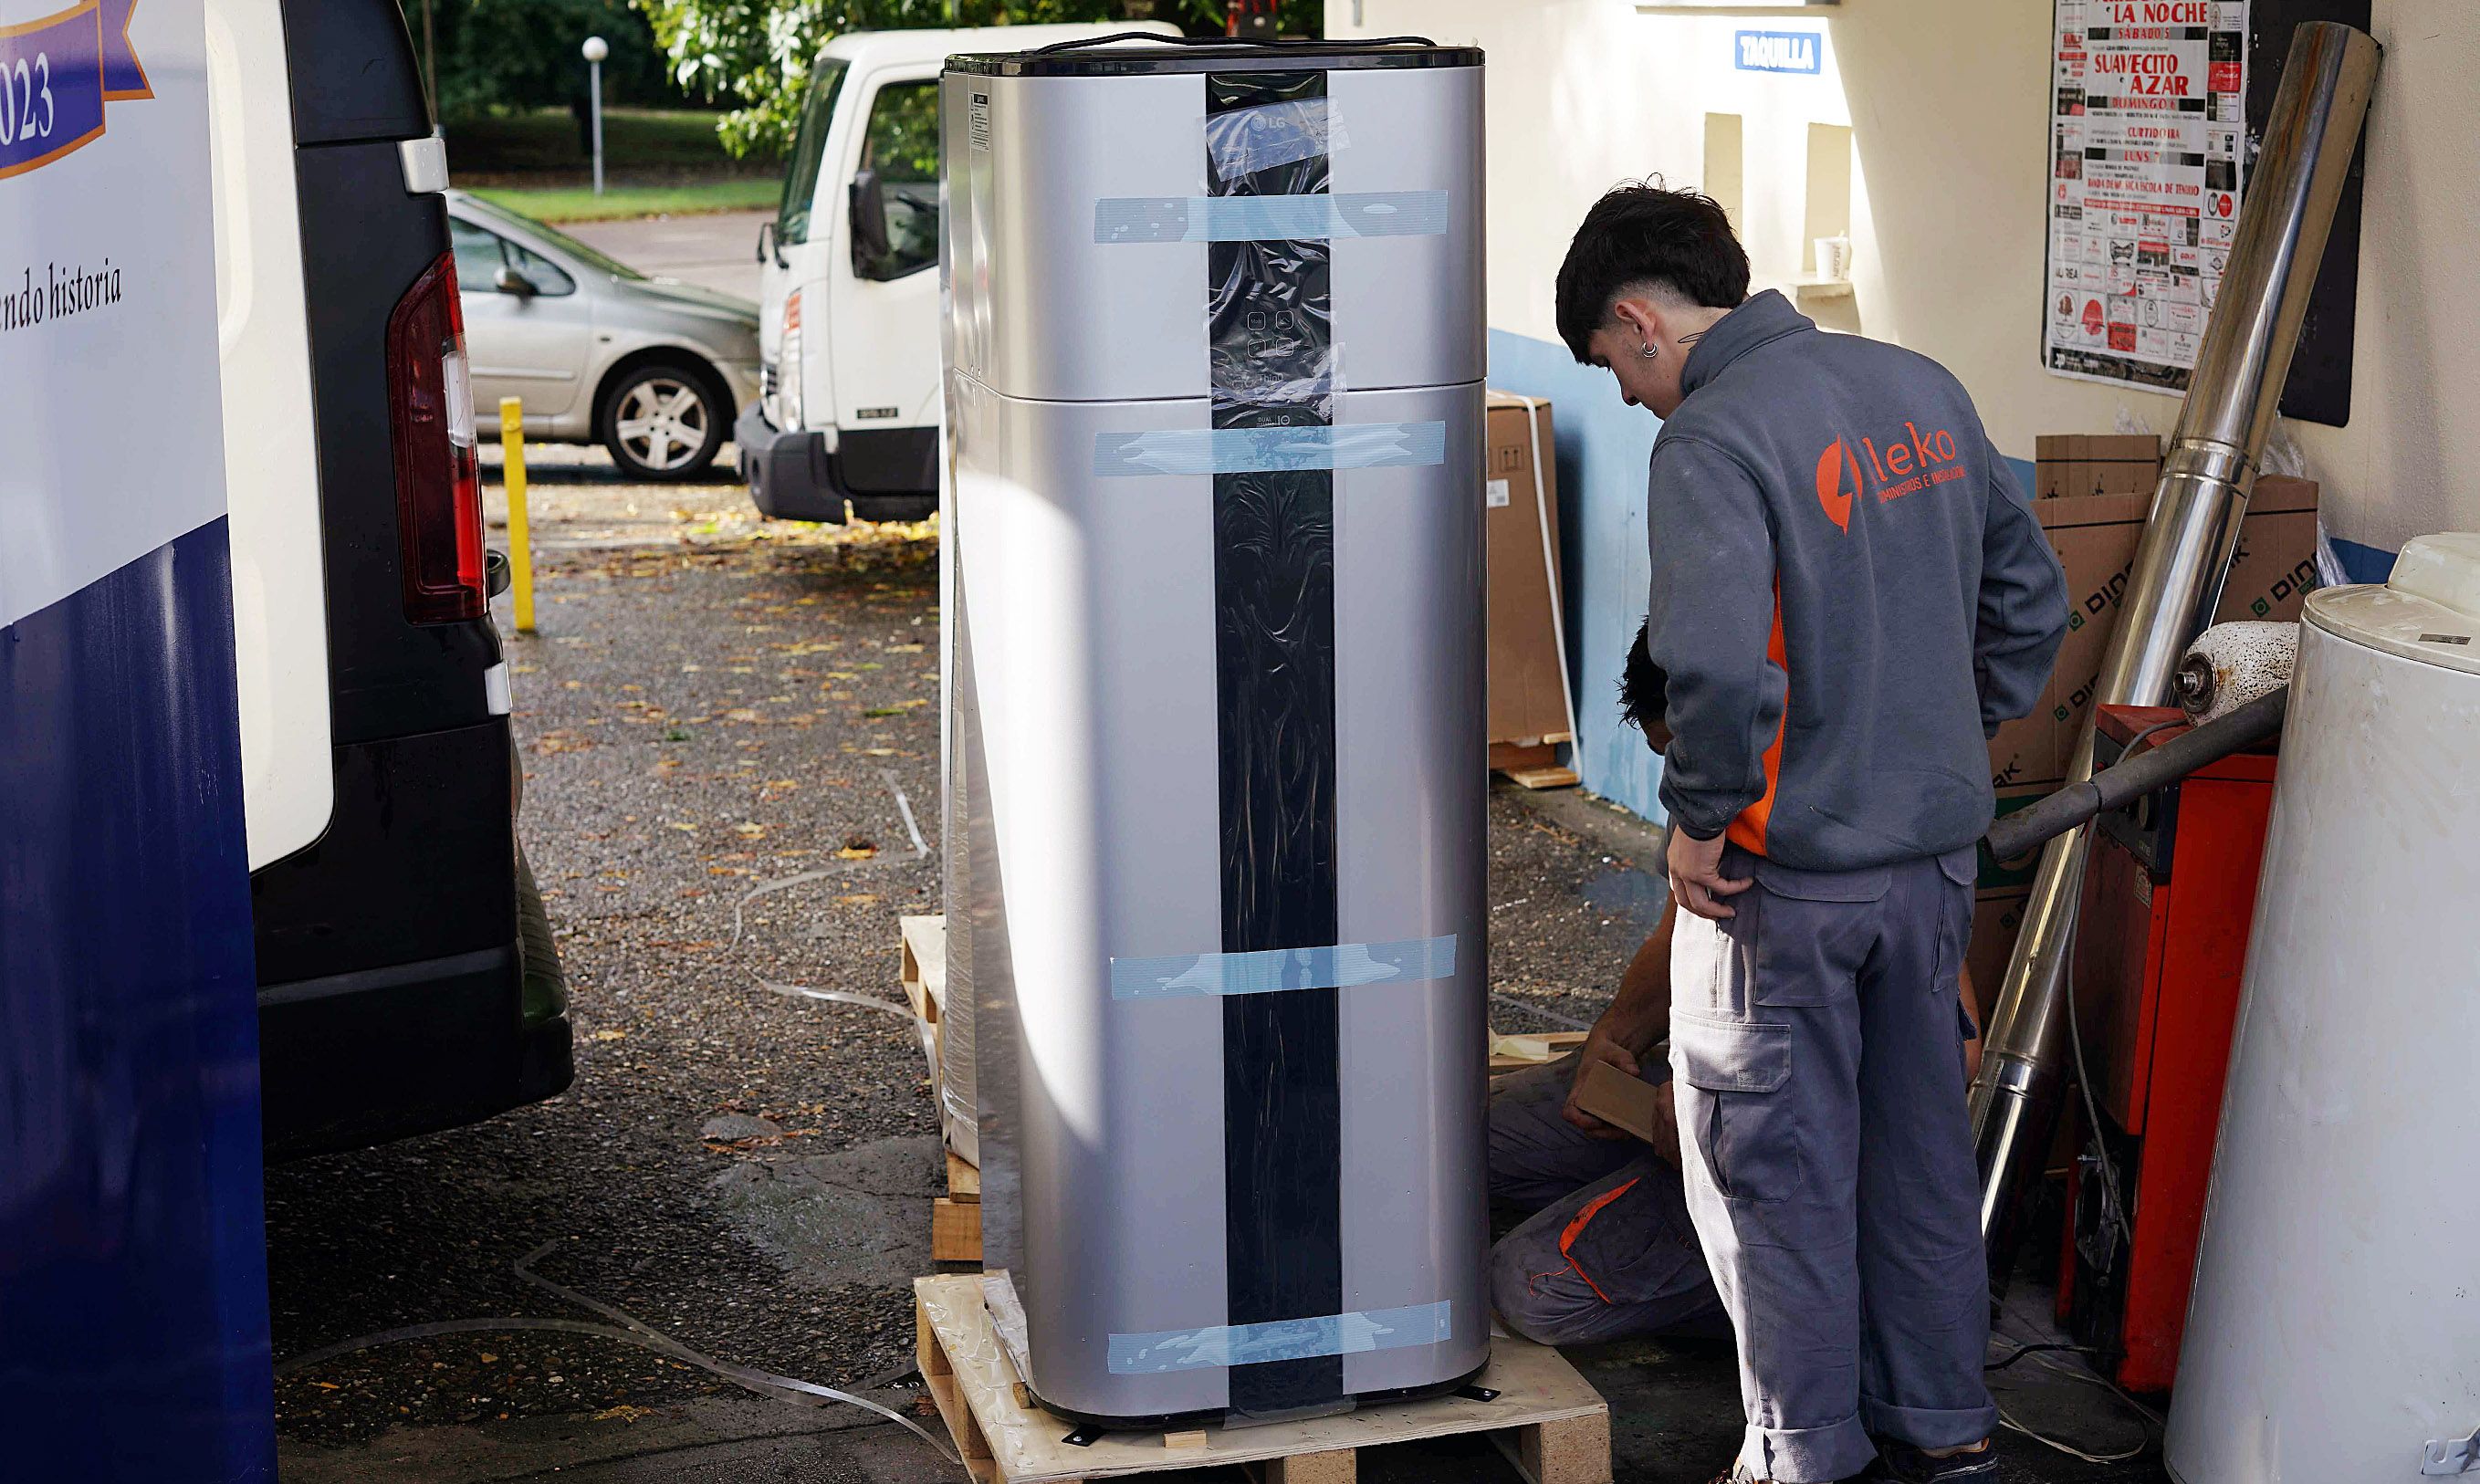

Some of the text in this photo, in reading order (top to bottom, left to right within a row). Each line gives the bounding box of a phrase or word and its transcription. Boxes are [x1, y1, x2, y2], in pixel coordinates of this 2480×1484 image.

[2114, 3, 2207, 24] LA NOCHE
[2119, 25, 2161, 39] SÁBADO
[1740, 36, 1815, 70] TAQUILLA
[2095, 53, 2179, 75] SUAVECITO
[2130, 75, 2189, 97] AZAR
[0, 52, 54, 146] 023
[2112, 97, 2167, 110] DOMINGO
[1269, 116, 1285, 129] LG
[0, 257, 121, 331] ndo historia
[1861, 421, 1956, 483] leko
[1922, 474, 1931, 487] E
